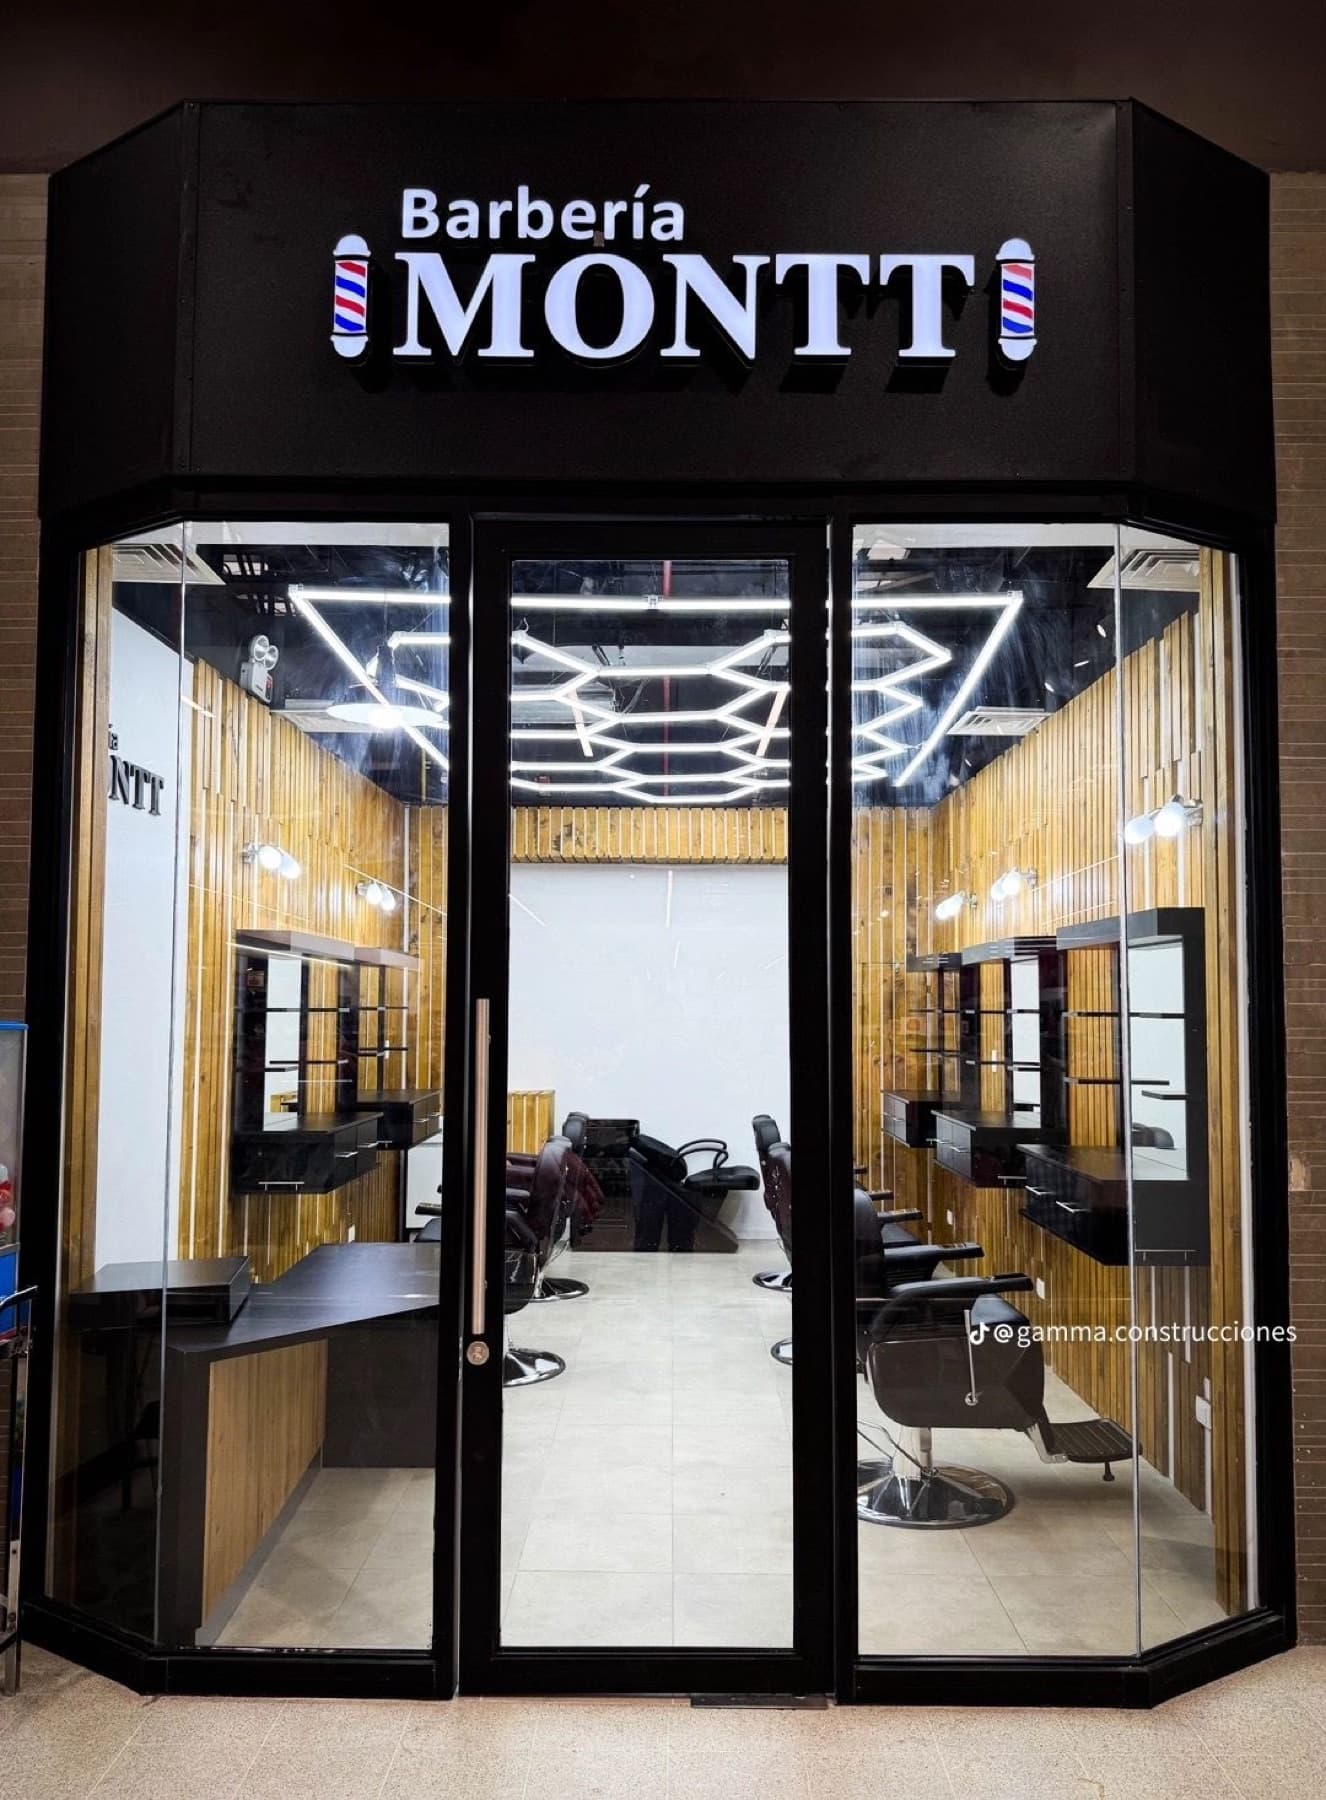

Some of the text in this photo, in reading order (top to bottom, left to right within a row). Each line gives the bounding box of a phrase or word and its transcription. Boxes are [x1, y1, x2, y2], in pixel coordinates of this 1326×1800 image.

[402, 184, 685, 241] Barbería
[393, 253, 976, 359] MONTT
[108, 755, 164, 816] NTT
